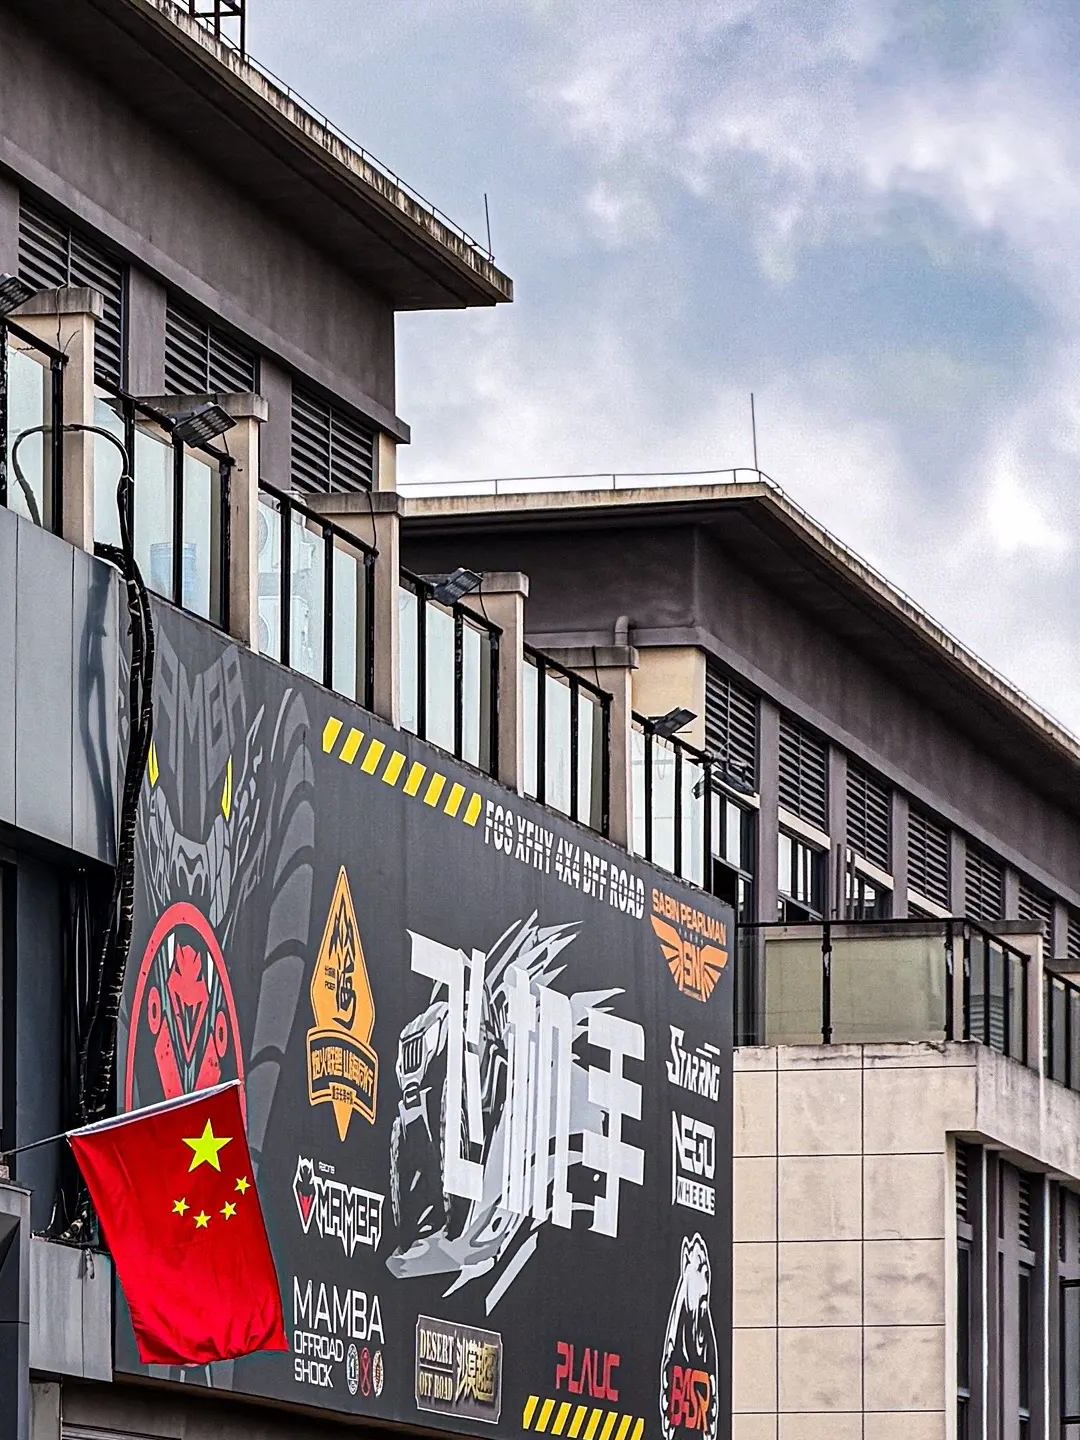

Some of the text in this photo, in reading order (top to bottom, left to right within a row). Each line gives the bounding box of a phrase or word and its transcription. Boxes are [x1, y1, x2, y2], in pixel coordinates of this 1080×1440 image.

[609, 863, 645, 920] ROAD
[677, 1177, 716, 1215] WHEELS
[293, 1275, 385, 1345] MAMBA
[293, 1330, 344, 1363] OFFROAD
[420, 1328, 454, 1365] DESERT
[294, 1360, 334, 1388] SHOCK
[419, 1372, 453, 1401] OFF ROAD
